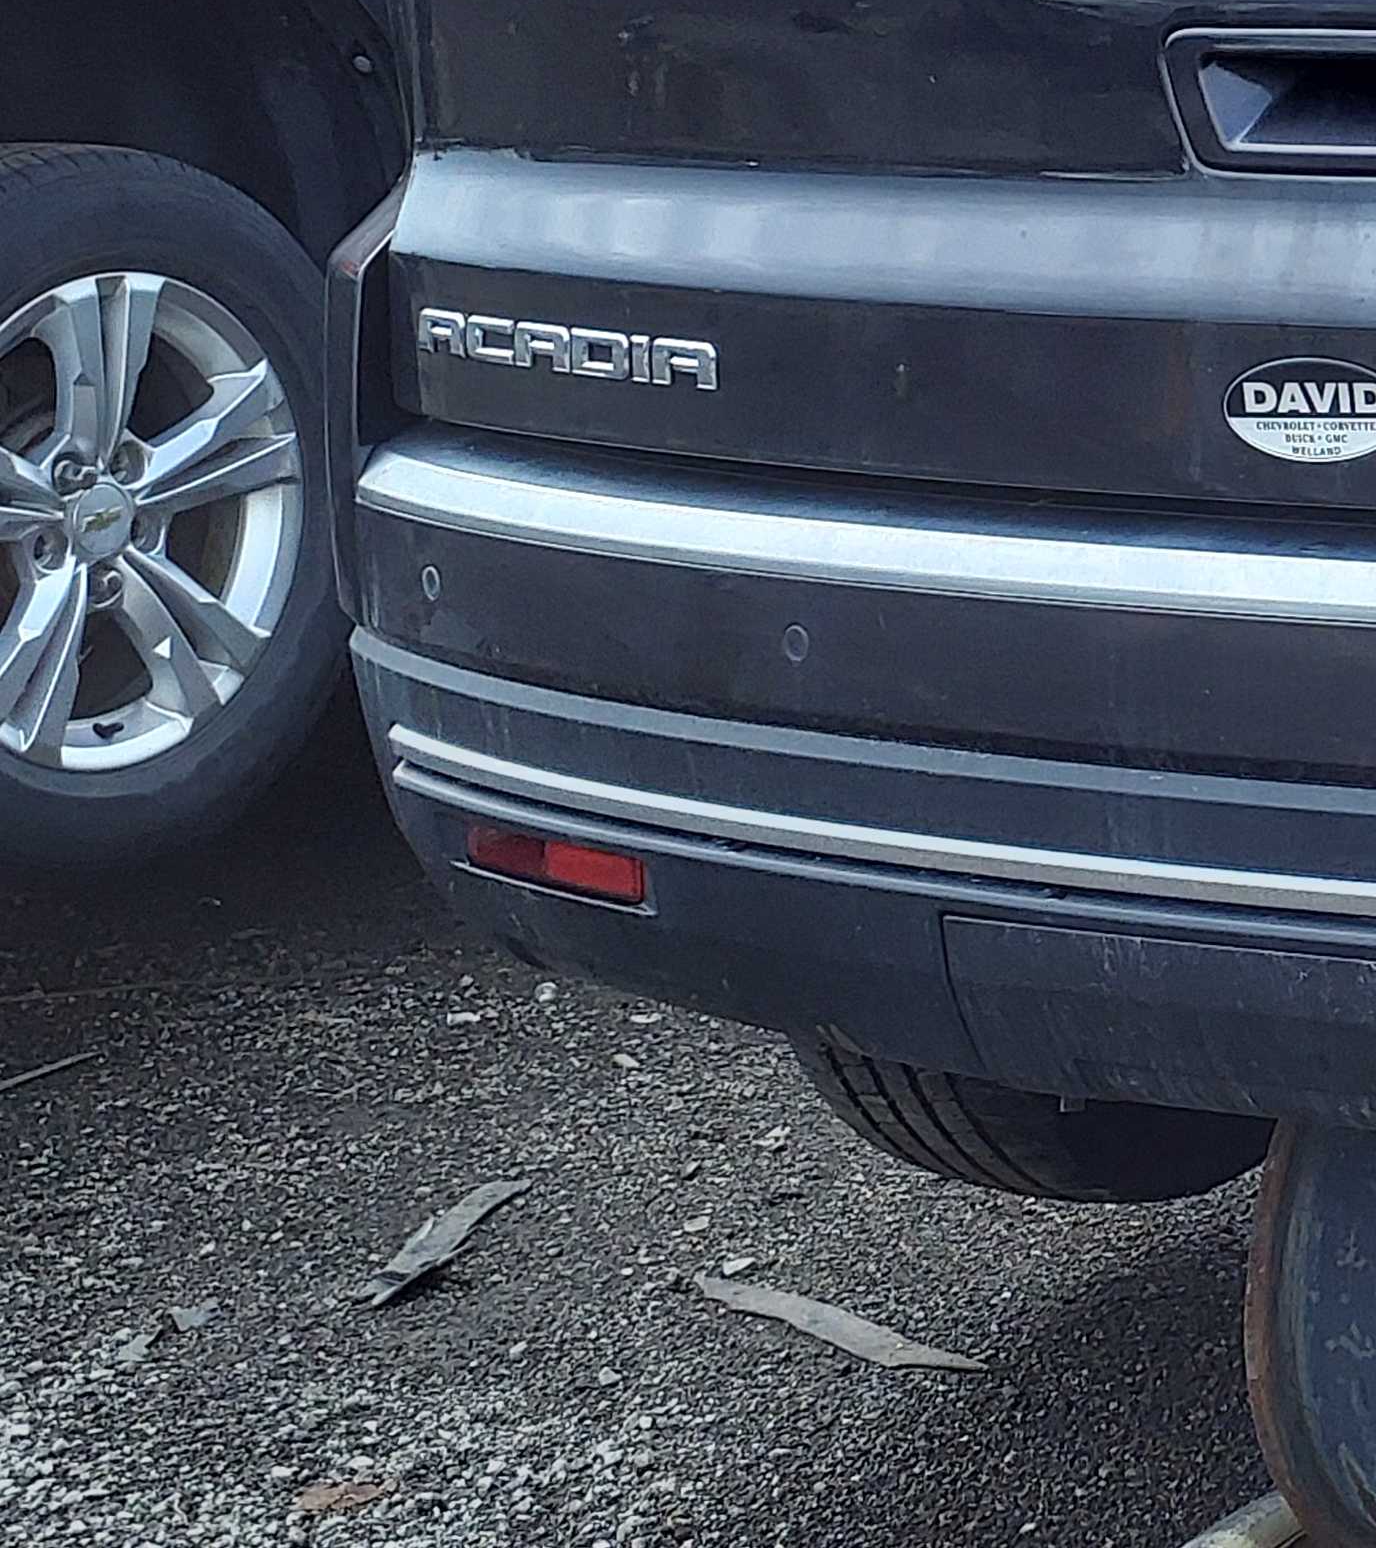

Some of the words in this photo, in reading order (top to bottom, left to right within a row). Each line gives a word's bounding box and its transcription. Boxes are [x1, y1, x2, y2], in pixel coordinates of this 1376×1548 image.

[418, 306, 720, 392] ACADIA
[1256, 421, 1315, 431] CHEVROLET
[1323, 422, 1376, 432] CORVETTE
[1285, 433, 1315, 443] BUICK
[1325, 434, 1348, 444] GMC
